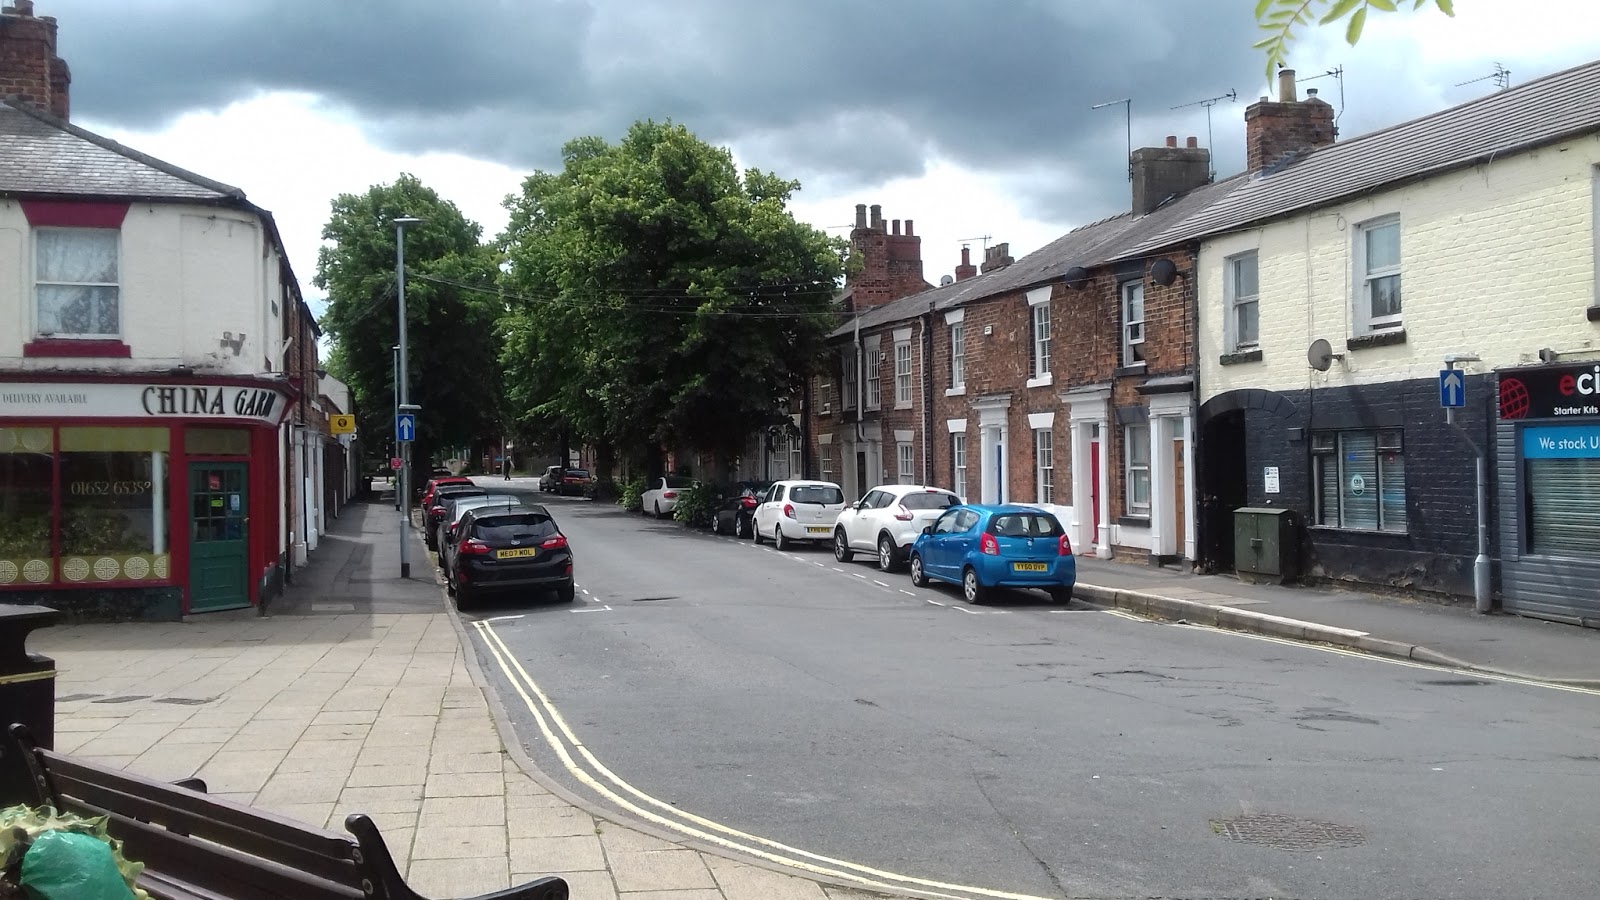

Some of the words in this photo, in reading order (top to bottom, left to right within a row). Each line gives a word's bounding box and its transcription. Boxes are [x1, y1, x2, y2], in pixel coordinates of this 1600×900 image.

[2, 393, 42, 403] DELIVERY
[44, 393, 88, 404] AVAILABLE
[142, 386, 226, 415] CHINA
[1553, 406, 1582, 415] Starter
[1583, 405, 1599, 414] Kits
[1539, 437, 1555, 450] We
[1558, 436, 1587, 450] stock
[1590, 436, 1600, 450] U
[71, 481, 109, 495] 01652
